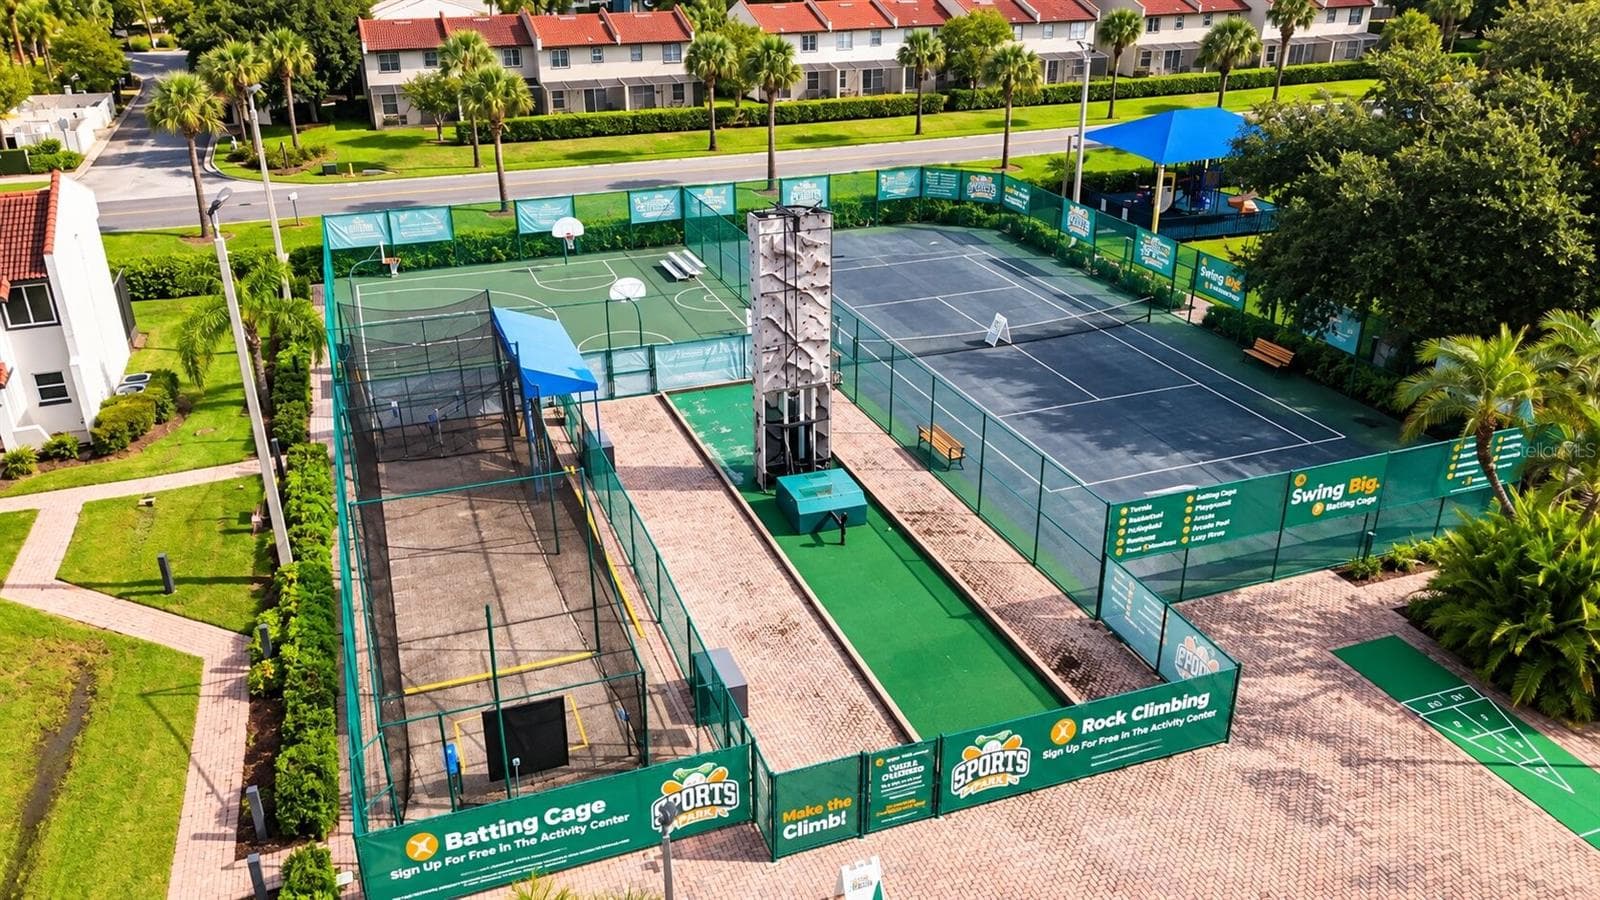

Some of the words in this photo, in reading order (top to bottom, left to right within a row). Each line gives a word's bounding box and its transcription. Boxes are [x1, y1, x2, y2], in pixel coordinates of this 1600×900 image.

[1291, 483, 1345, 505] Swing
[1326, 499, 1356, 511] Batting
[1081, 710, 1127, 734] Rock
[1131, 692, 1211, 720] Climbing
[1042, 748, 1064, 760] Sign
[1066, 744, 1079, 754] Up
[1081, 738, 1097, 750] For
[1098, 734, 1119, 746] Free
[1131, 727, 1149, 737] The
[1150, 717, 1185, 732] Activity
[1186, 709, 1217, 723] Center
[953, 749, 1028, 791] SPORTS
[444, 816, 538, 851] Batting
[544, 800, 606, 825] Cage
[782, 804, 824, 823] Make
[827, 797, 852, 812] the
[783, 810, 847, 840] Climb!
[390, 865, 420, 880] Sign
[423, 860, 442, 872] Up
[445, 854, 467, 866] For
[469, 847, 496, 860] Free
[514, 836, 537, 849] The
[541, 824, 587, 842] Activity
[590, 814, 630, 830] Center
